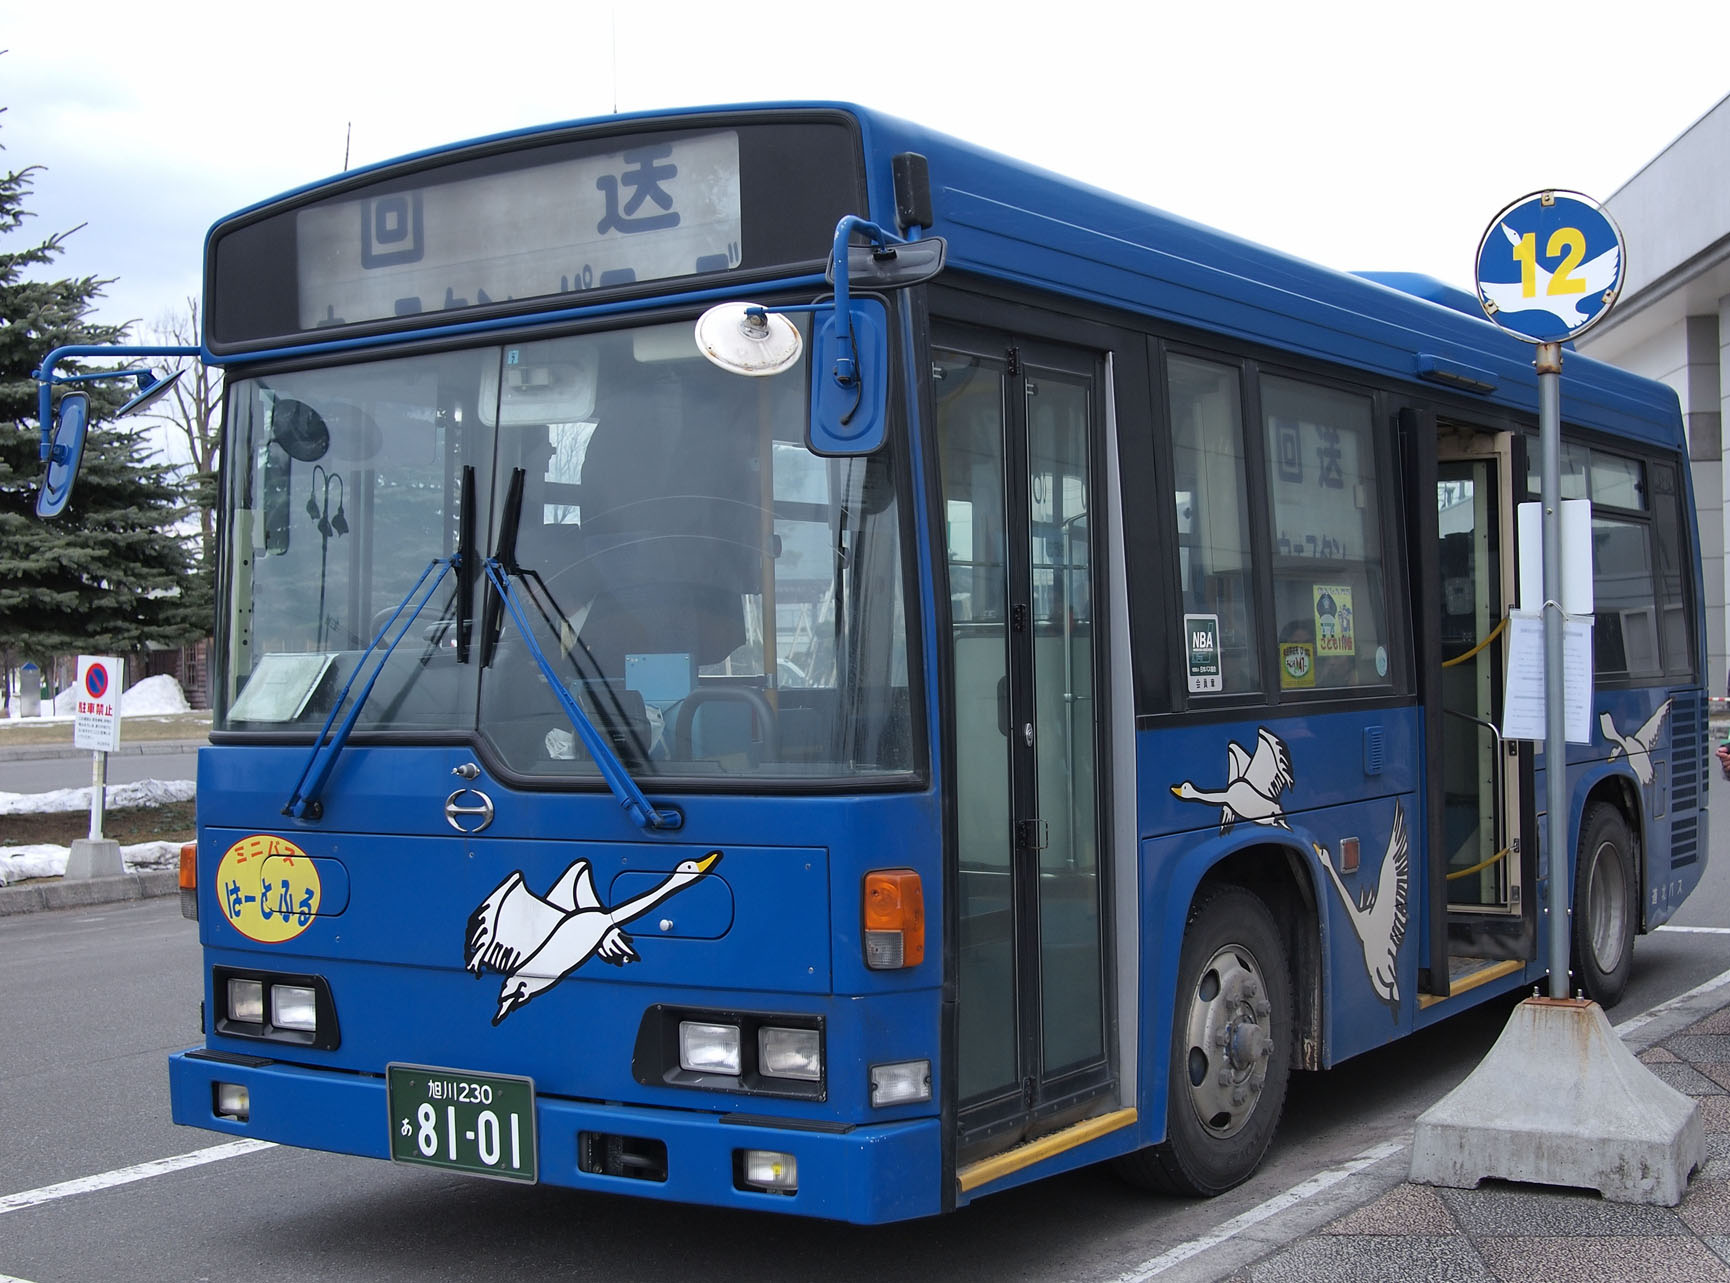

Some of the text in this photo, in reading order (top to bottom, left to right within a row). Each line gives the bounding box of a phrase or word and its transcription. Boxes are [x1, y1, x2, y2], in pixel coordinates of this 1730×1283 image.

[1512, 226, 1587, 299] 12
[1192, 631, 1214, 649] NBA
[78, 701, 113, 717] 駐車禁止
[234, 840, 296, 867] ミニバス
[224, 877, 315, 927] はーとふる
[400, 1102, 521, 1170] あ 81-01
